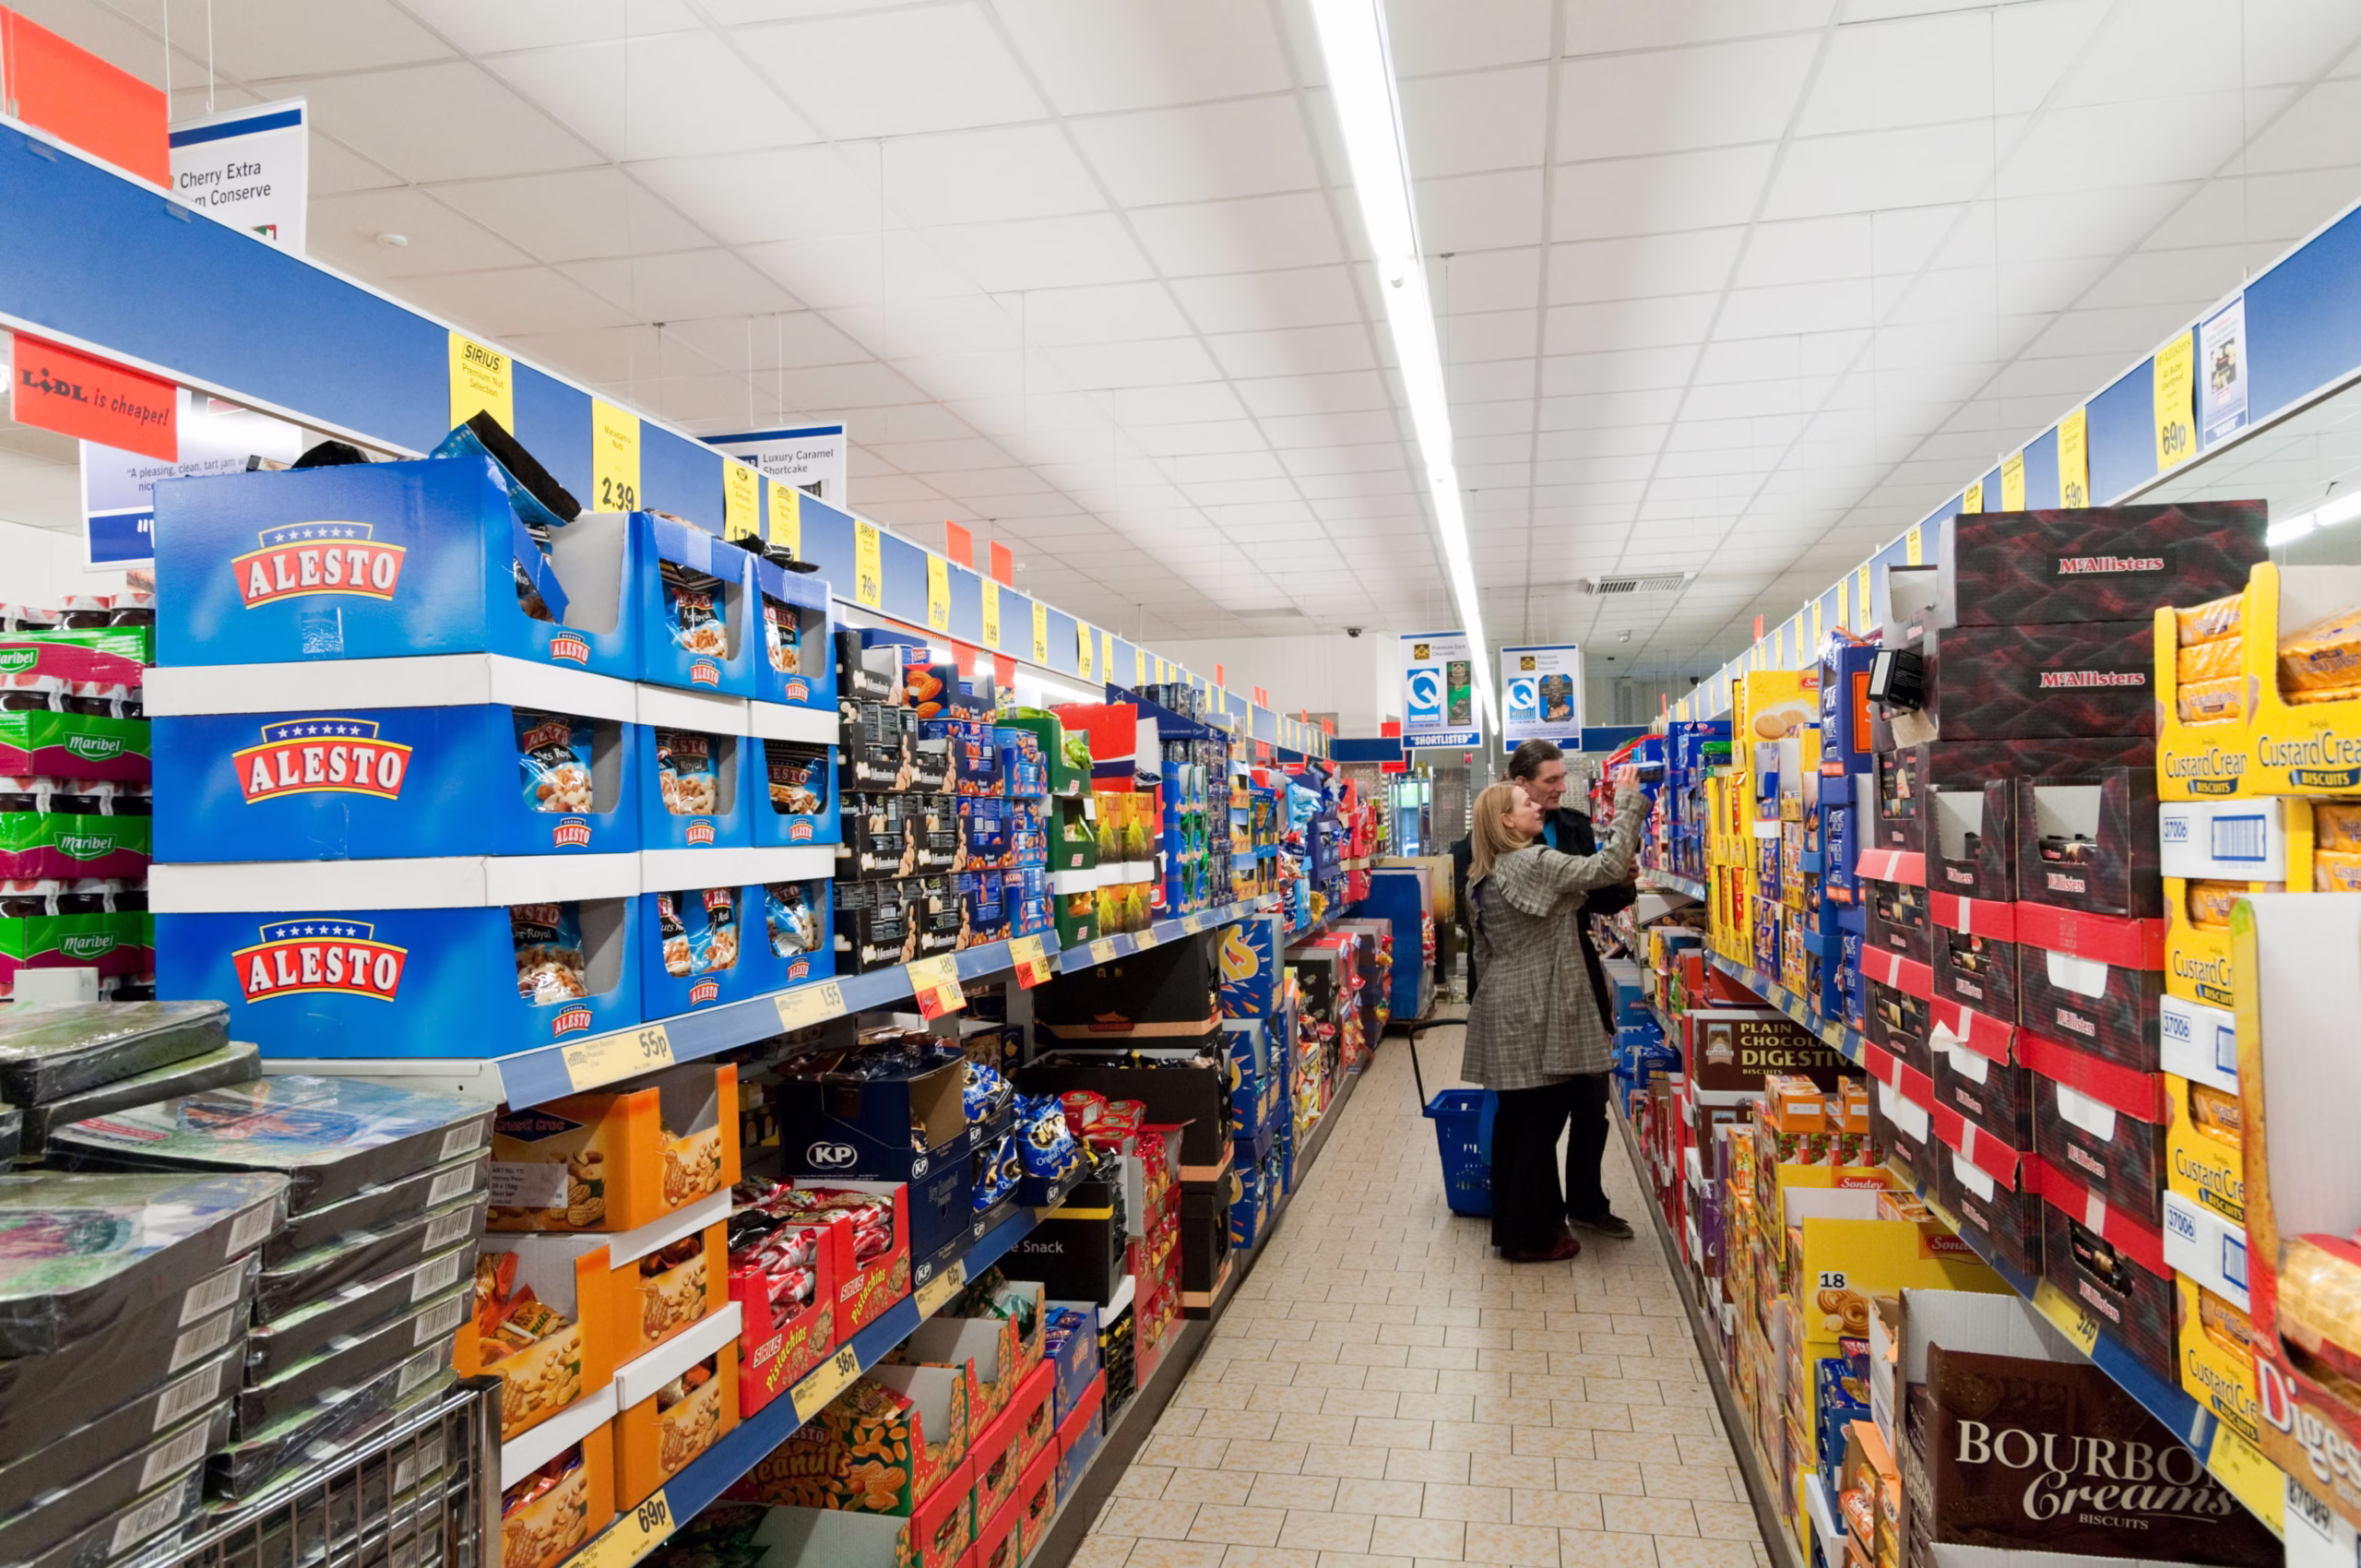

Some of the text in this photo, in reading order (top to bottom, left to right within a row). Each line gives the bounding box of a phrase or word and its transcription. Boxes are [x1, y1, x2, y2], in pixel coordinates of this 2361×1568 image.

[181, 161, 261, 189] Cherry Extra
[211, 184, 271, 206] Conserve
[465, 344, 500, 371] SIRIUS
[462, 362, 504, 389] Premium Nut
[469, 379, 498, 398] Selection
[94, 388, 106, 407] is
[112, 395, 170, 426] cheaper!
[2163, 421, 2186, 456] 69p
[763, 453, 793, 465] Luxury
[796, 448, 834, 461] Caramel
[139, 464, 177, 481] pleasing,
[205, 459, 219, 470] tart
[220, 457, 236, 470] jam
[763, 465, 808, 475] Shortcake
[602, 477, 634, 511] 2.39
[2065, 481, 2082, 508] 59p
[245, 547, 397, 600] ALESTO
[2058, 556, 2164, 575] McAllisters
[861, 575, 876, 600] 79p
[0, 651, 34, 665] aribel
[552, 641, 589, 664] ALESTO
[693, 667, 720, 685] ALESTO
[2039, 671, 2145, 688] McAllisters
[787, 685, 810, 700] ALESTO
[69, 735, 121, 753] Maribel
[2259, 733, 2319, 767] Custard
[248, 745, 402, 794] ALESTO
[2165, 750, 2210, 778] Custard
[2196, 781, 2230, 793] BISCUITS
[2301, 771, 2351, 786] BISCUITS
[554, 827, 591, 845] ALESTO
[688, 826, 715, 844] ALESTO
[791, 826, 812, 840] ALESTO
[2164, 820, 2188, 838] 37006
[61, 836, 113, 850] Maribel
[2047, 873, 2085, 893] McAllisters
[64, 934, 113, 951] Maribel
[527, 928, 552, 940] Royal
[248, 946, 397, 993] ALESTO
[788, 964, 810, 980] ALESTO
[2173, 950, 2233, 987] Custard Cr
[692, 987, 719, 1004] ALESTO
[821, 985, 840, 1007] 1.55
[2204, 985, 2233, 1006] BISCUIT
[553, 1013, 591, 1035] ALESTO
[1740, 1023, 1791, 1034] PLAIN
[2057, 1007, 2095, 1037] McAllisters
[2164, 1016, 2189, 1038] 37006
[638, 1030, 667, 1059] 55p
[1740, 1036, 1830, 1048] CHOCOLA
[1742, 1050, 1854, 1067] DIGESTIV
[964, 1092, 985, 1105] riginal
[495, 1119, 565, 1132] Crusti Croc
[970, 1127, 980, 1141] KP
[815, 1146, 852, 1163] KP
[2068, 1142, 2106, 1179] McAllisters
[915, 1159, 926, 1175] KP
[2175, 1148, 2223, 1193] Custard
[1048, 1188, 1058, 1201] KP
[1841, 1178, 1883, 1190] Sondey
[2208, 1194, 2243, 1219] BISCUITS
[974, 1223, 984, 1236] KP
[2167, 1209, 2194, 1237] 37006
[1025, 1241, 1063, 1254] Snack
[917, 1265, 930, 1284] KP
[1821, 1274, 1845, 1288] 18
[841, 1277, 864, 1301] SIRIUS
[850, 1267, 885, 1325] Pistachios
[2079, 1277, 2119, 1324] McAllisters
[755, 1337, 780, 1365] SIRIUS
[766, 1324, 807, 1392] Pistachios
[836, 1349, 856, 1377] 38p
[2188, 1348, 2236, 1406] Custard
[2221, 1405, 2259, 1441] BISCUITS
[793, 1429, 824, 1443] ESTO
[1955, 1420, 2215, 1489] BOURBO
[2023, 1471, 2232, 1521] Creams
[638, 1500, 666, 1533] 69p
[2079, 1513, 2150, 1531] BISCUITS
[583, 1530, 615, 1558] Salted Peanuts
